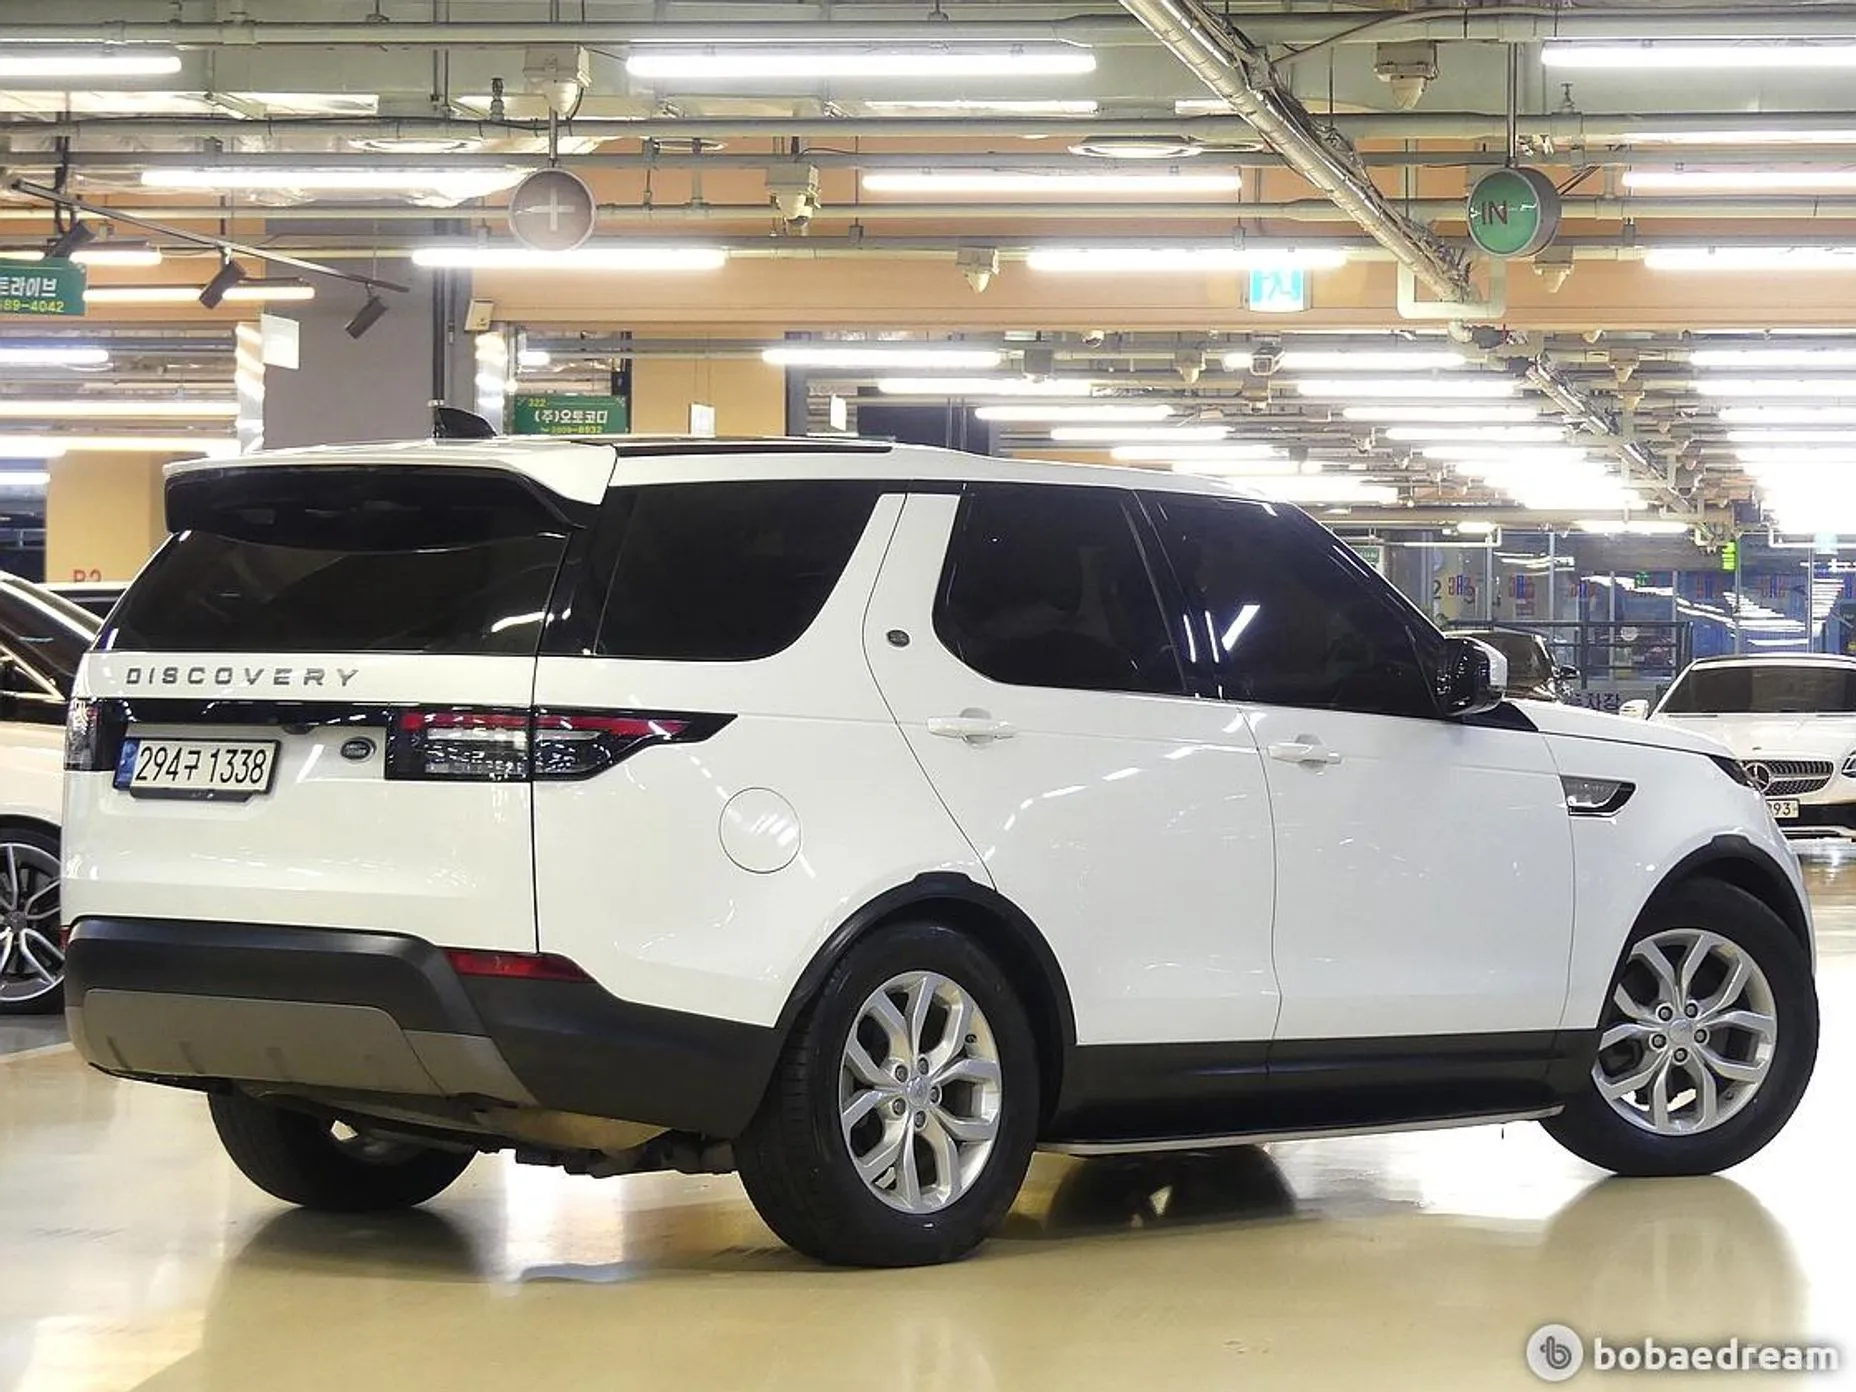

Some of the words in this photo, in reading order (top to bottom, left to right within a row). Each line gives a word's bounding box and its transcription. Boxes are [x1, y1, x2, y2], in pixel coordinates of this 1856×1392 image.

[1481, 200, 1508, 225] IN
[126, 667, 360, 687] DISCOVERY
[136, 746, 202, 783] 294구
[209, 748, 267, 784] 1338
